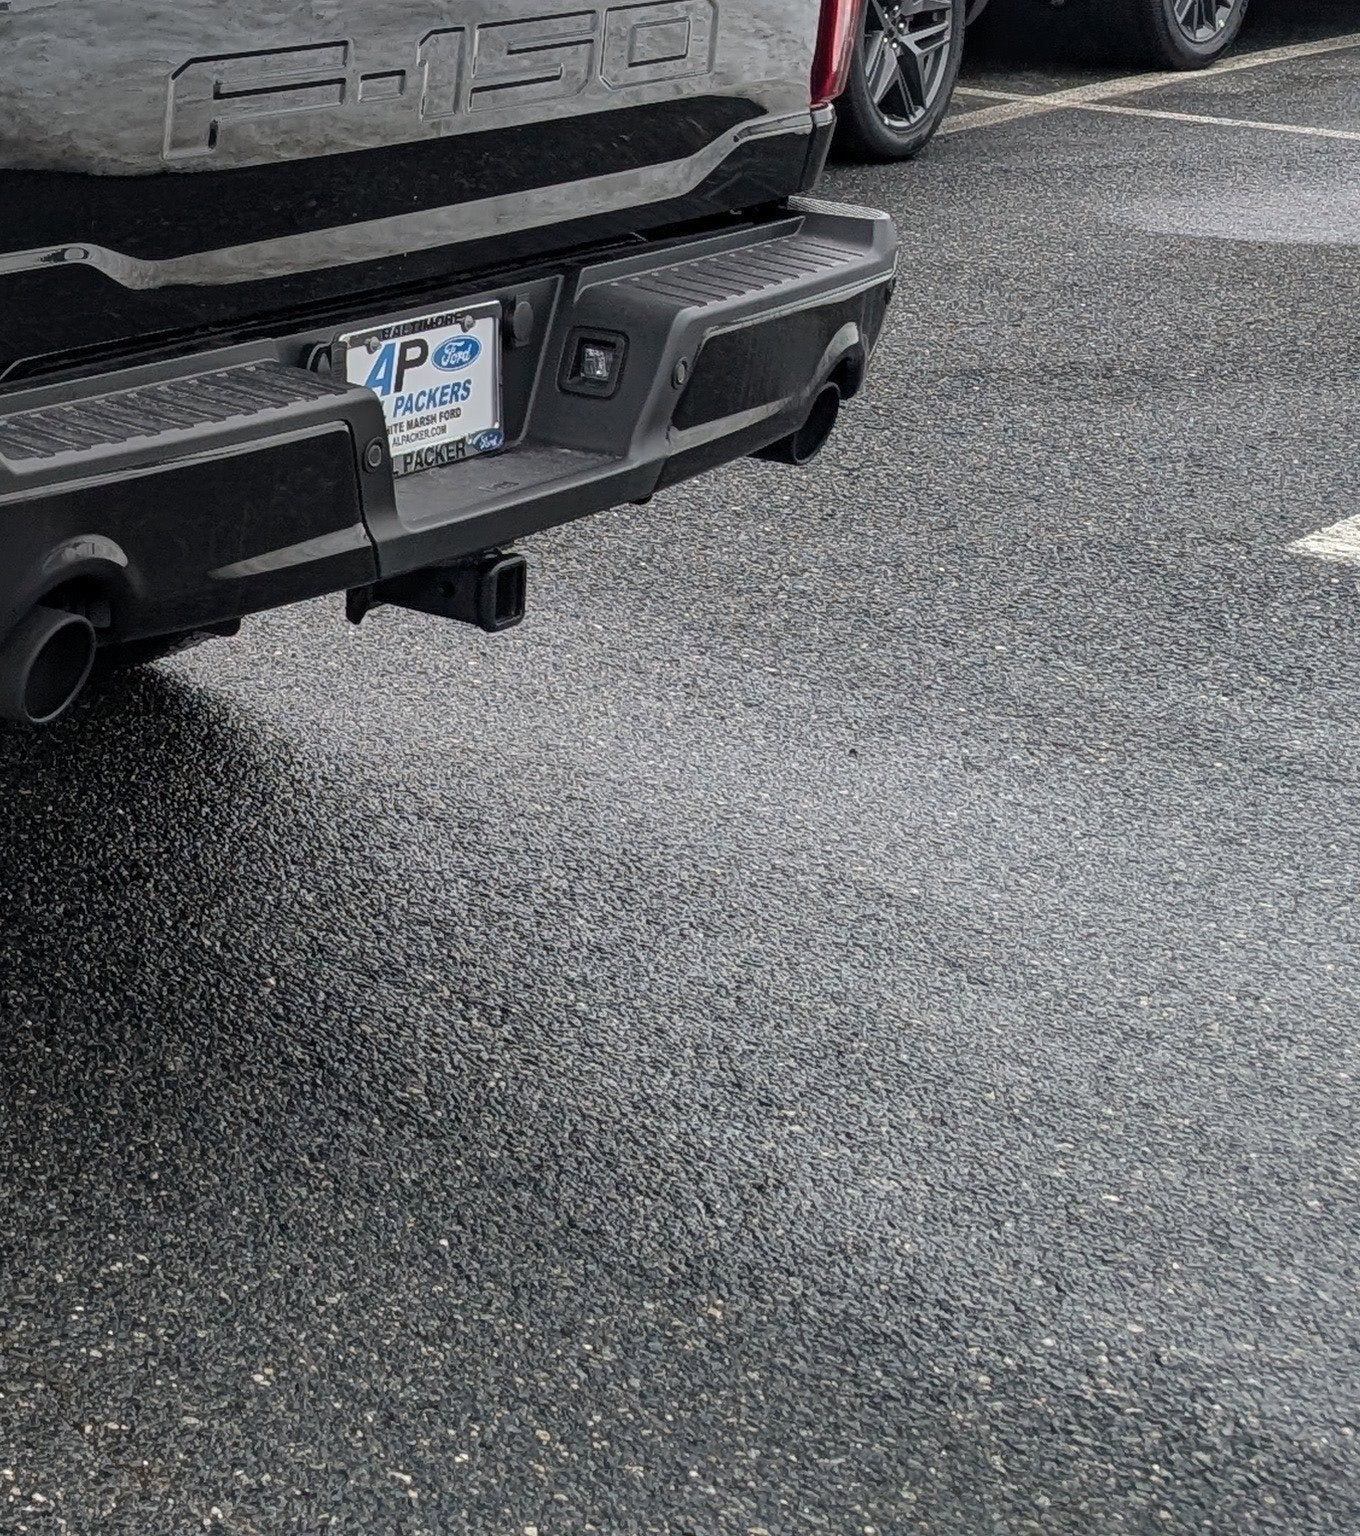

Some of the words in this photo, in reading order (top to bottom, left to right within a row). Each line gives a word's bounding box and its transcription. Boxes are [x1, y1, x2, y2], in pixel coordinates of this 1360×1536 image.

[381, 313, 464, 340] BALTIMORE
[440, 341, 473, 367] Ford
[365, 339, 429, 397] AP
[392, 377, 472, 419] PACKERS
[406, 412, 437, 431] MARSH
[439, 406, 462, 423] FORD
[391, 424, 448, 448] ALPACKER.COM
[403, 437, 467, 473] PACKER
